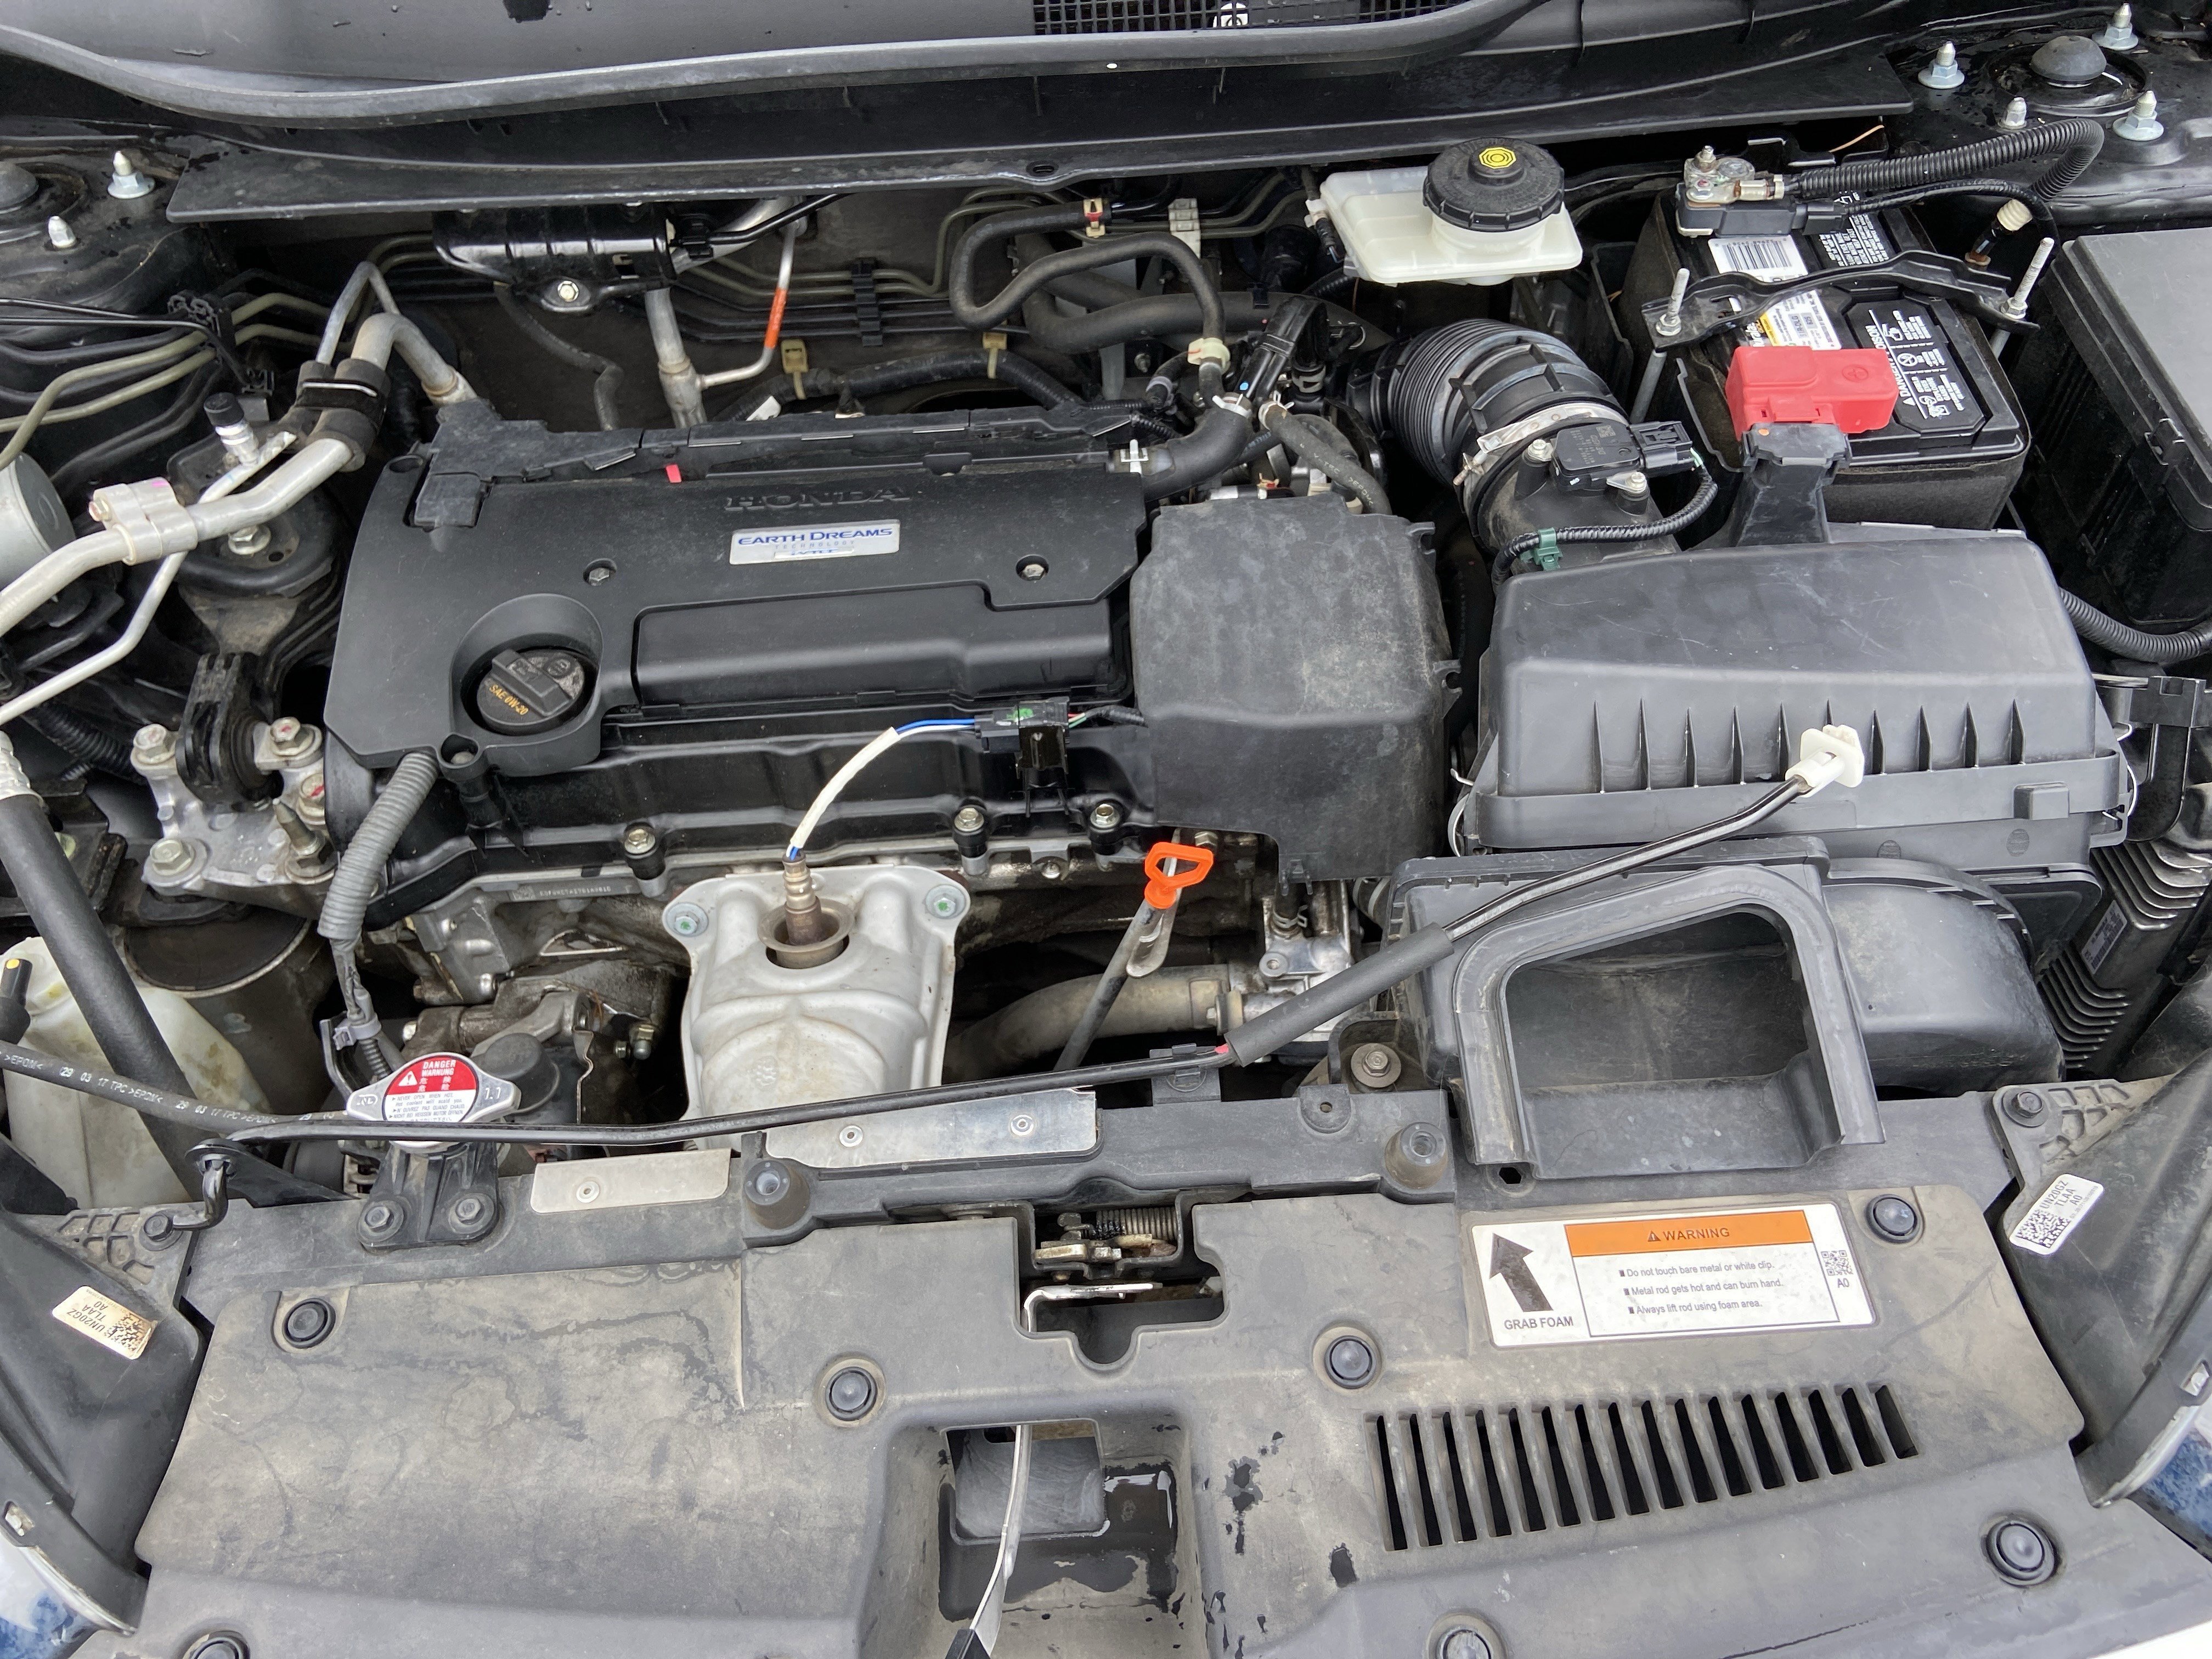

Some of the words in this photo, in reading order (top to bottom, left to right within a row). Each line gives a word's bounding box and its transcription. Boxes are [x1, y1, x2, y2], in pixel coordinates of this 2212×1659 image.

[1745, 322, 1765, 347] urala
[724, 486, 911, 511] HONDA
[738, 534, 805, 545] EARTH
[810, 528, 893, 540] DREAMS
[489, 684, 508, 699] SAE
[504, 696, 529, 715] 0W-20
[421, 1068, 455, 1077] WARNUNG
[422, 1059, 457, 1069] DANGER
[60, 1066, 75, 1078] 29
[80, 1072, 92, 1083] 03
[110, 1081, 128, 1093] TPC
[484, 1086, 501, 1100] 1.1
[2054, 1188, 2076, 1206] TLAA
[1662, 1227, 1730, 1240] WARNING
[1627, 1269, 1639, 1277] Do
[1641, 1268, 1654, 1276] not
[1656, 1266, 1678, 1276] touch
[1679, 1265, 1698, 1274] bare
[1700, 1262, 1722, 1273] metal
[1734, 1261, 1756, 1271] white
[1758, 1260, 1775, 1272] clip.
[1632, 1286, 1654, 1295] Metal
[1656, 1285, 1670, 1294] rod
[1672, 1284, 1689, 1295] gets
[1690, 1283, 1703, 1292] hot
[1706, 1282, 1721, 1291] and
[1723, 1282, 1739, 1290] can
[1740, 1280, 1758, 1289] burn
[1760, 1278, 1784, 1288] hand.
[82, 1305, 106, 1322] TLAA
[1637, 1306, 1666, 1316] Always
[1667, 1304, 1678, 1313] lift
[1679, 1303, 1692, 1312] rod
[1694, 1302, 1717, 1312] using
[1718, 1301, 1739, 1310] foam
[1741, 1300, 1762, 1308] area.
[66, 1308, 105, 1333] UN20GZ
[1504, 1318, 1537, 1330] GRAB
[1540, 1316, 1574, 1328] FOAM
